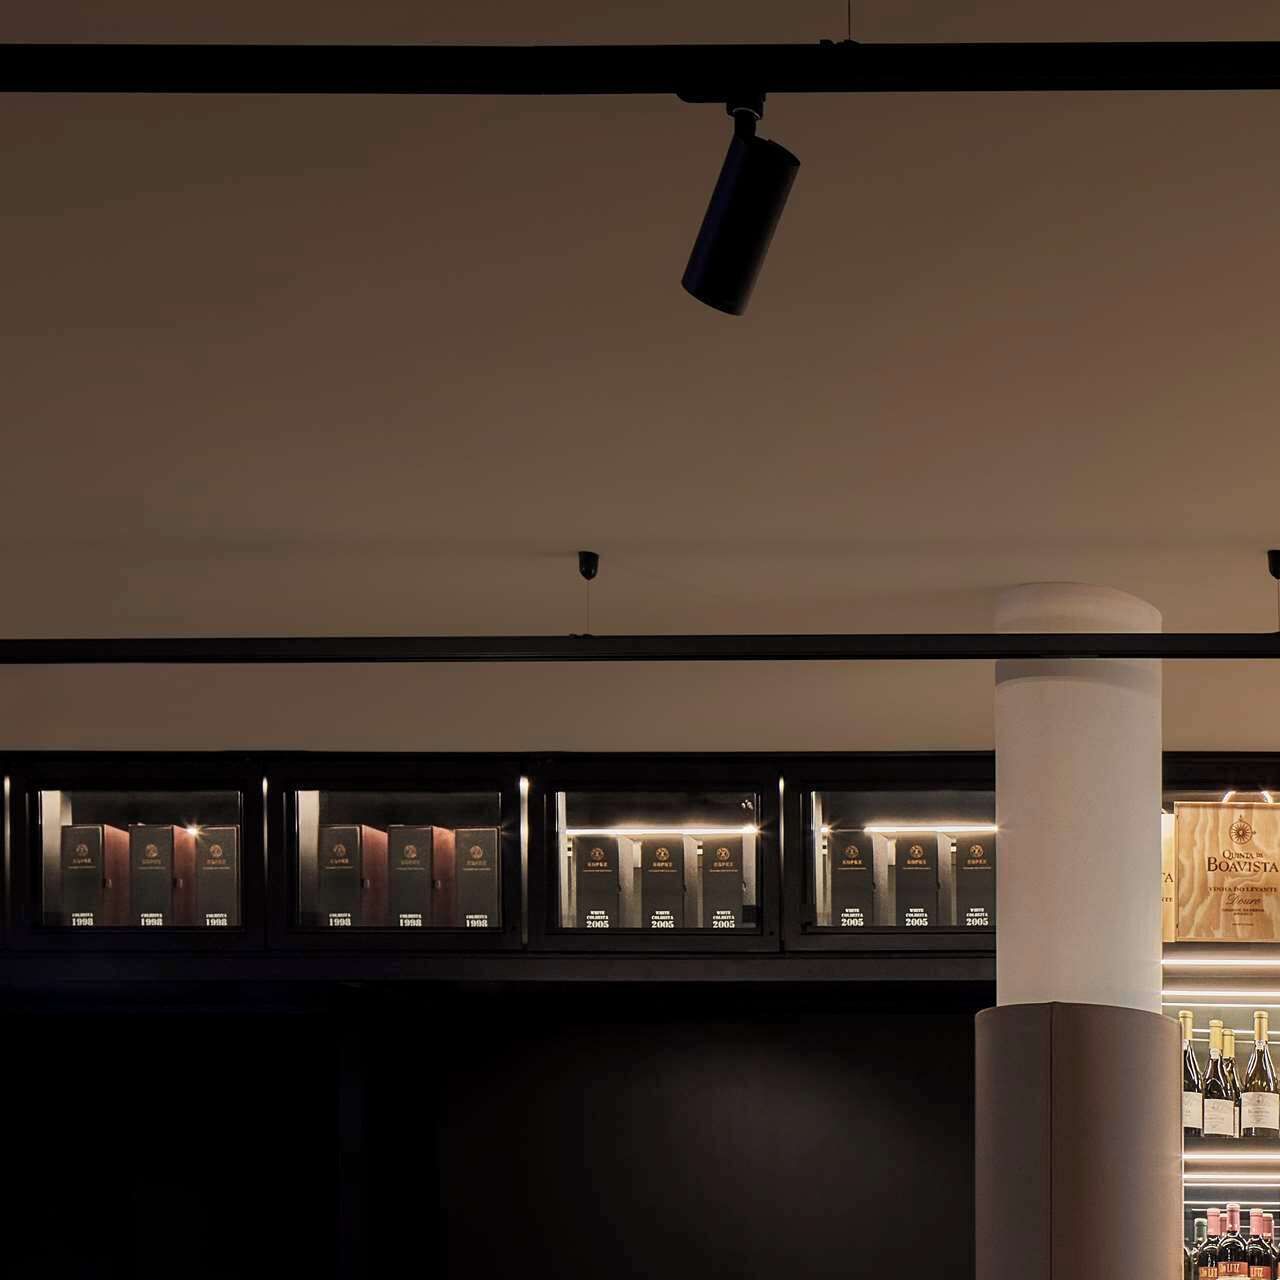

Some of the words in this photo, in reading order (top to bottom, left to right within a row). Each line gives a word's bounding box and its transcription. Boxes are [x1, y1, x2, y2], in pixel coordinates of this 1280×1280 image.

[1222, 850, 1254, 860] QUINTA
[1207, 857, 1279, 873] BOAVISTA
[72, 918, 93, 926] 1998
[141, 918, 162, 926] 1998
[329, 918, 351, 926] 1998
[841, 918, 864, 926] 2005
[905, 918, 928, 926] 2005
[966, 918, 988, 926] 2005
